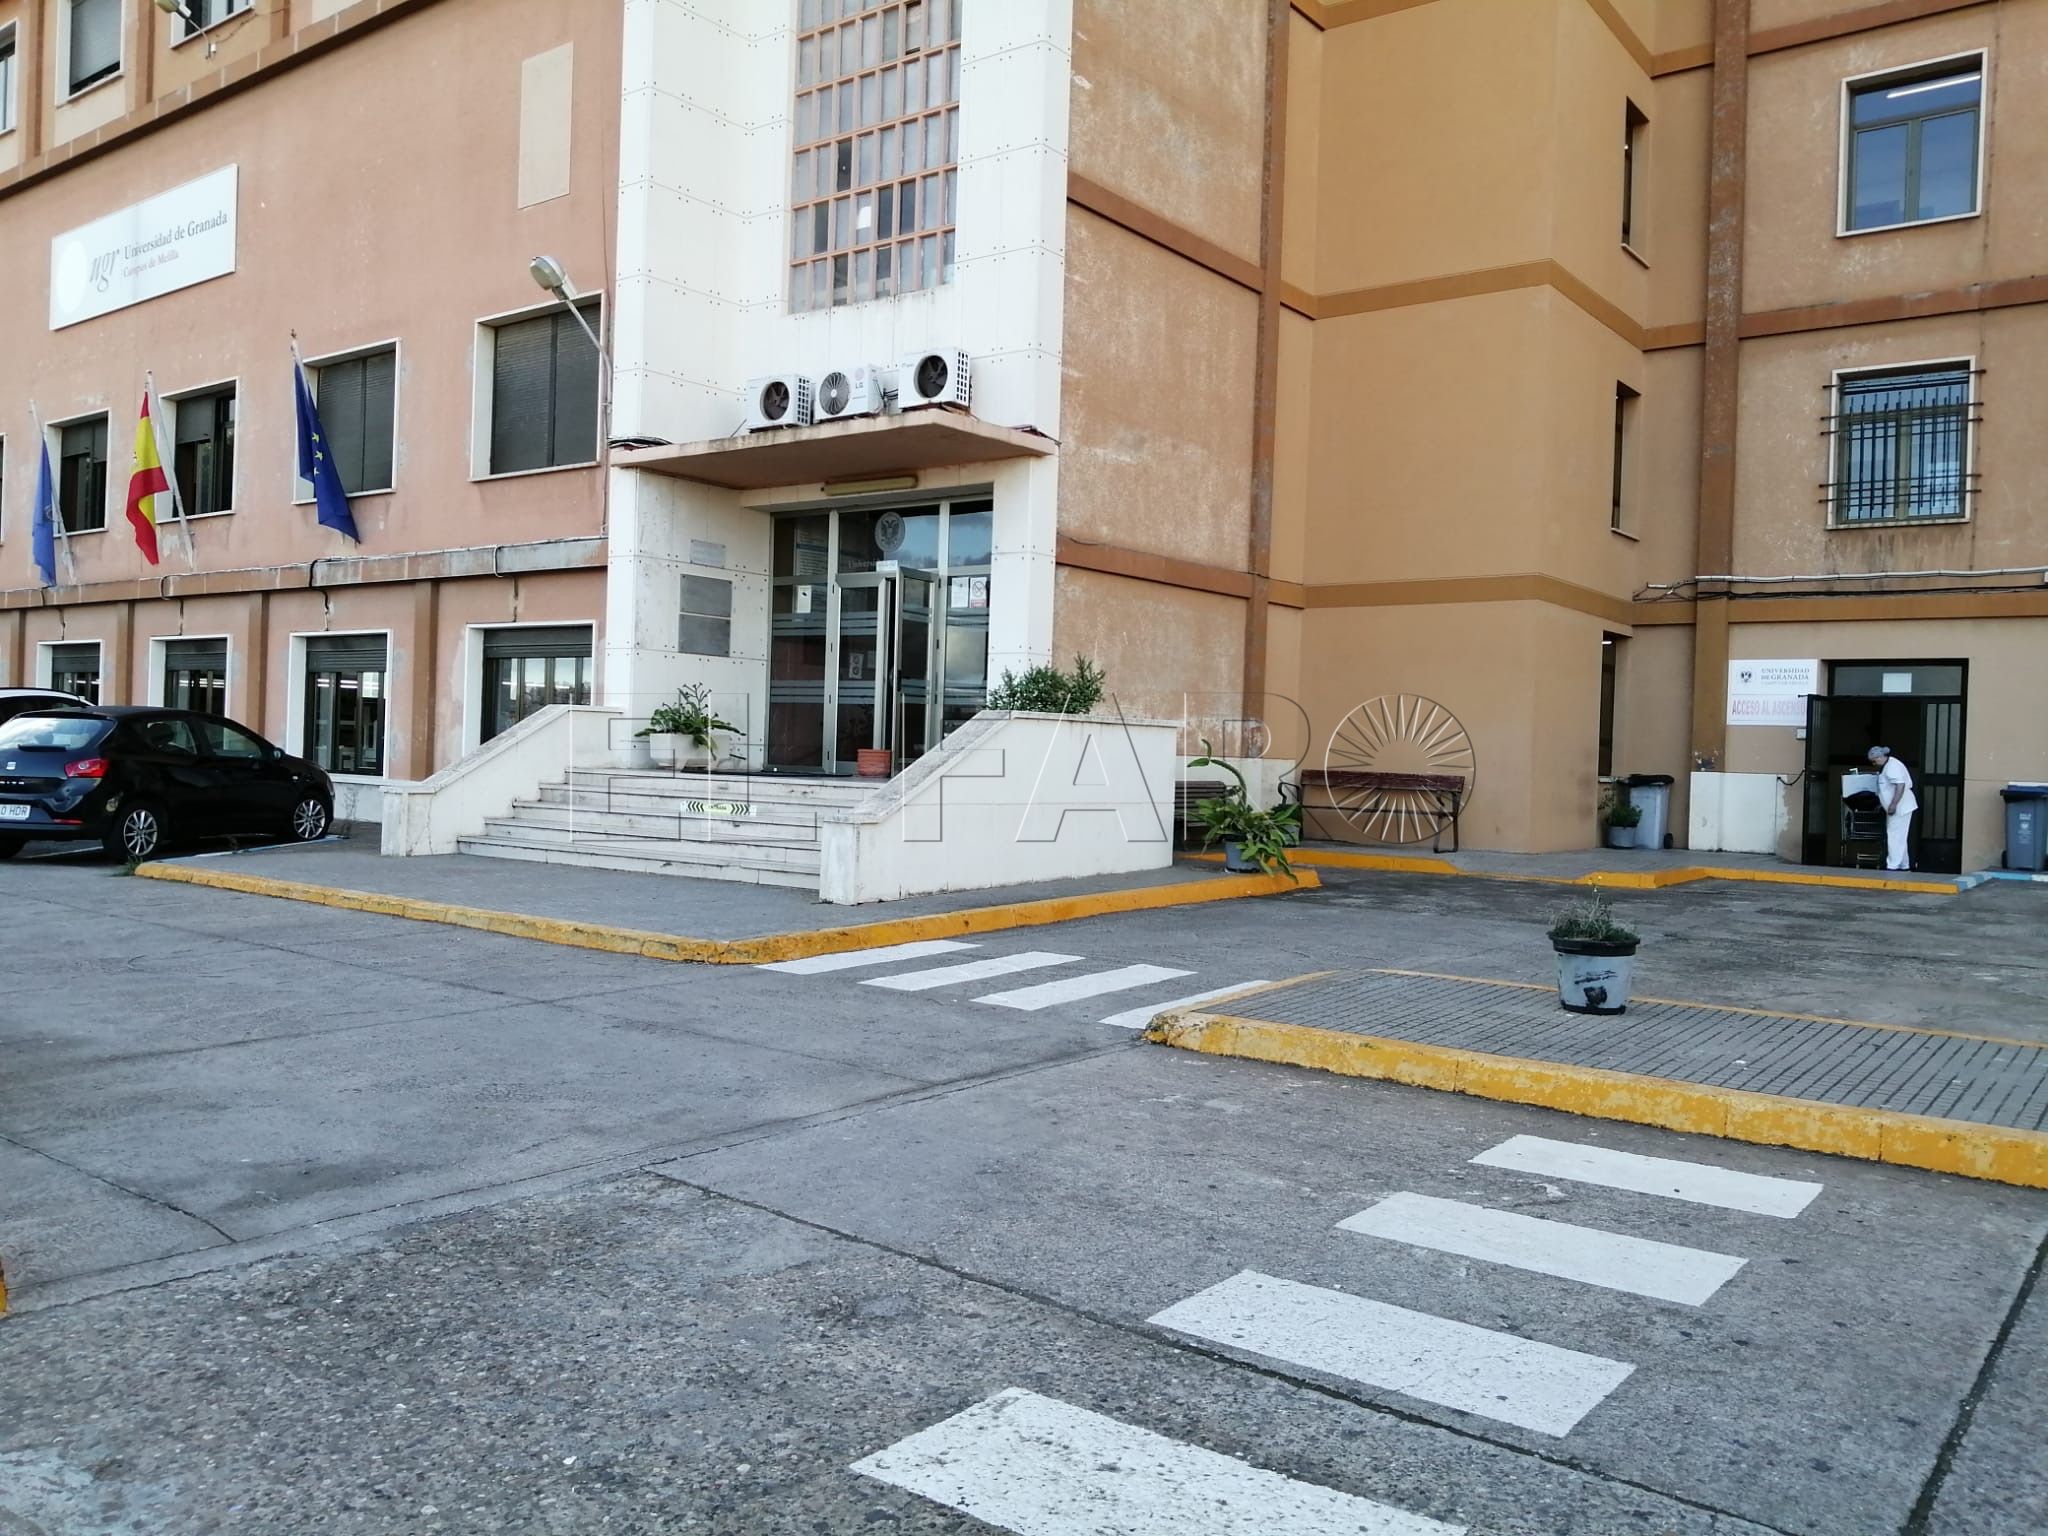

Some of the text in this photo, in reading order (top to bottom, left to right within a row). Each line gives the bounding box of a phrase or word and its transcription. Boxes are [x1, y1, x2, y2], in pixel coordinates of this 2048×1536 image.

[124, 210, 228, 260] Universidad de Granada
[1770, 673, 1809, 681] GRANADA
[1732, 699, 1760, 716] ACCESO
[1772, 699, 1806, 716] ASCENSO
